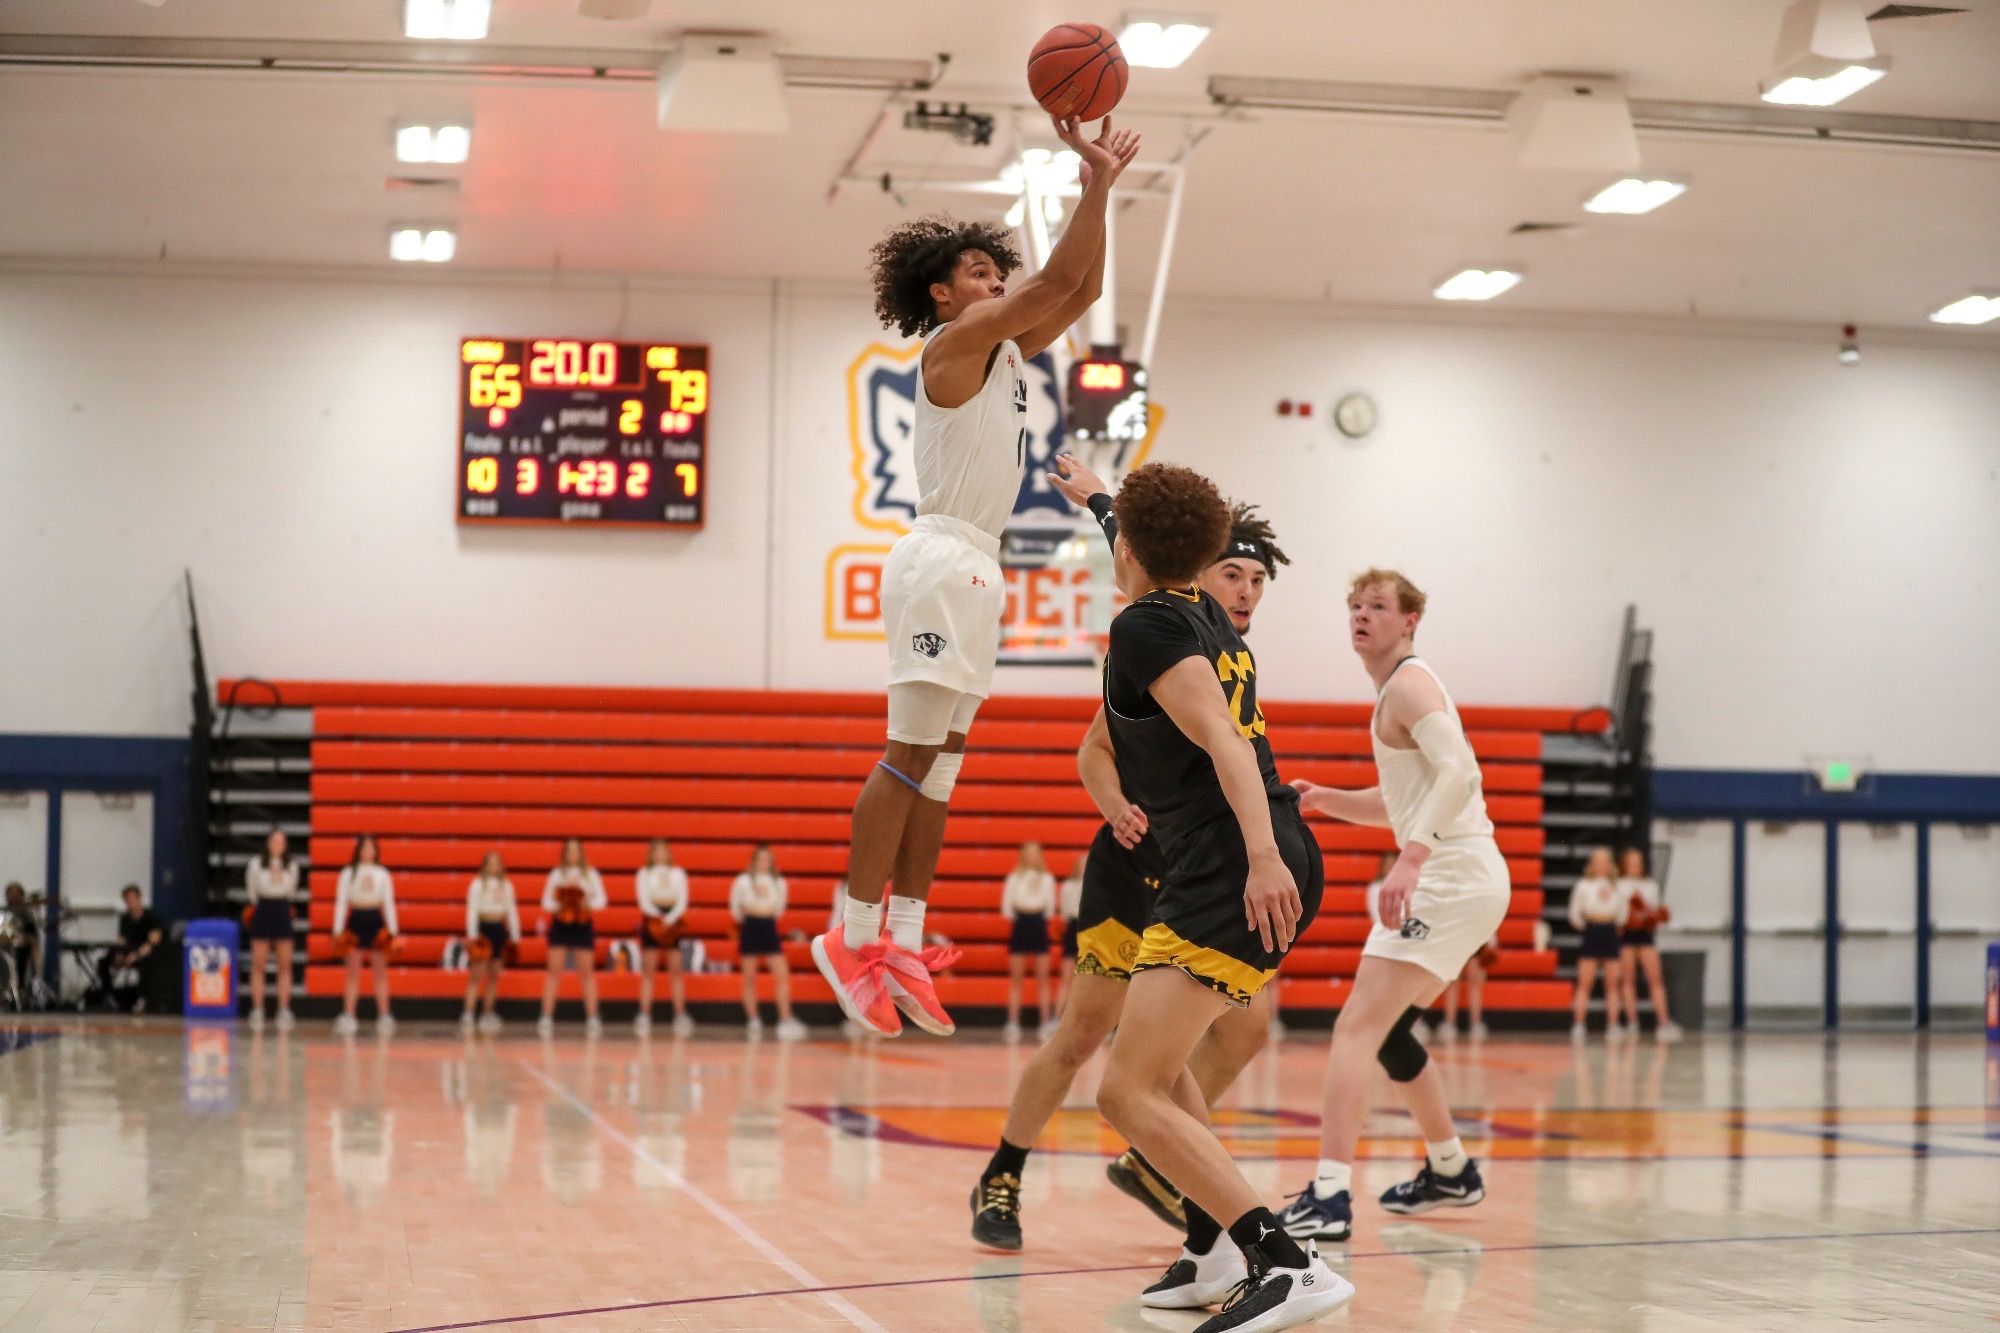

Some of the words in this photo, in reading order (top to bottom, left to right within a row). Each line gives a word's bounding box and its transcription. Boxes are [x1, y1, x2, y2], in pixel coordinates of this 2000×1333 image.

[530, 340, 617, 386] 20.0
[469, 363, 522, 408] 65
[656, 369, 708, 414] 79
[619, 399, 644, 434] 2
[466, 457, 498, 493] 10
[515, 457, 540, 495] 3
[624, 460, 650, 498] 2
[674, 462, 698, 497] 7
